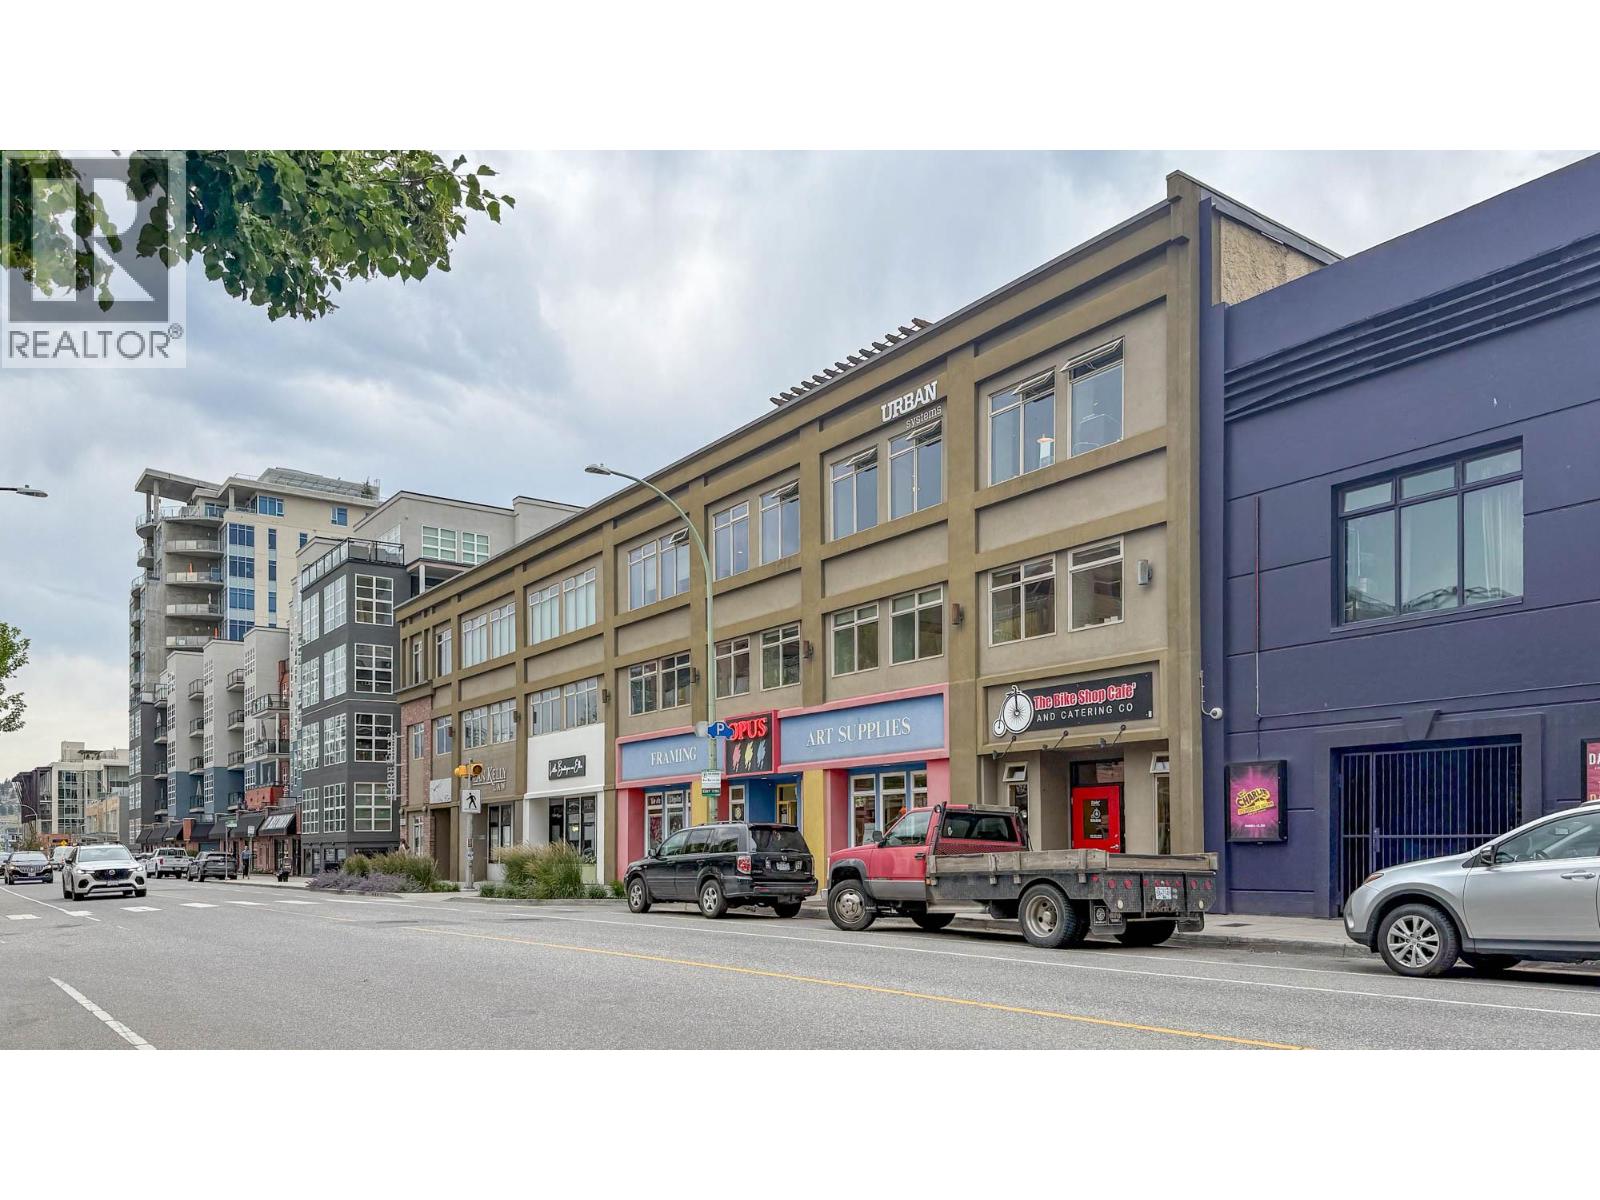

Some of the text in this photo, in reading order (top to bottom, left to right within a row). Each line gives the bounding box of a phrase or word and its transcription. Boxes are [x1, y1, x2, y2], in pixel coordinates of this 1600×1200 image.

[881, 380, 938, 422] URBAN
[906, 405, 942, 429] systems
[1033, 695, 1053, 711] The
[1053, 692, 1077, 708] Bike
[1078, 688, 1106, 705] Shop
[1037, 703, 1133, 722] AND CATERING CO
[716, 723, 725, 736] P
[728, 718, 768, 741] OPUS
[806, 717, 911, 747] ART SUPPLIES
[651, 746, 697, 766] FRAMING
[487, 766, 506, 785] KELLY
